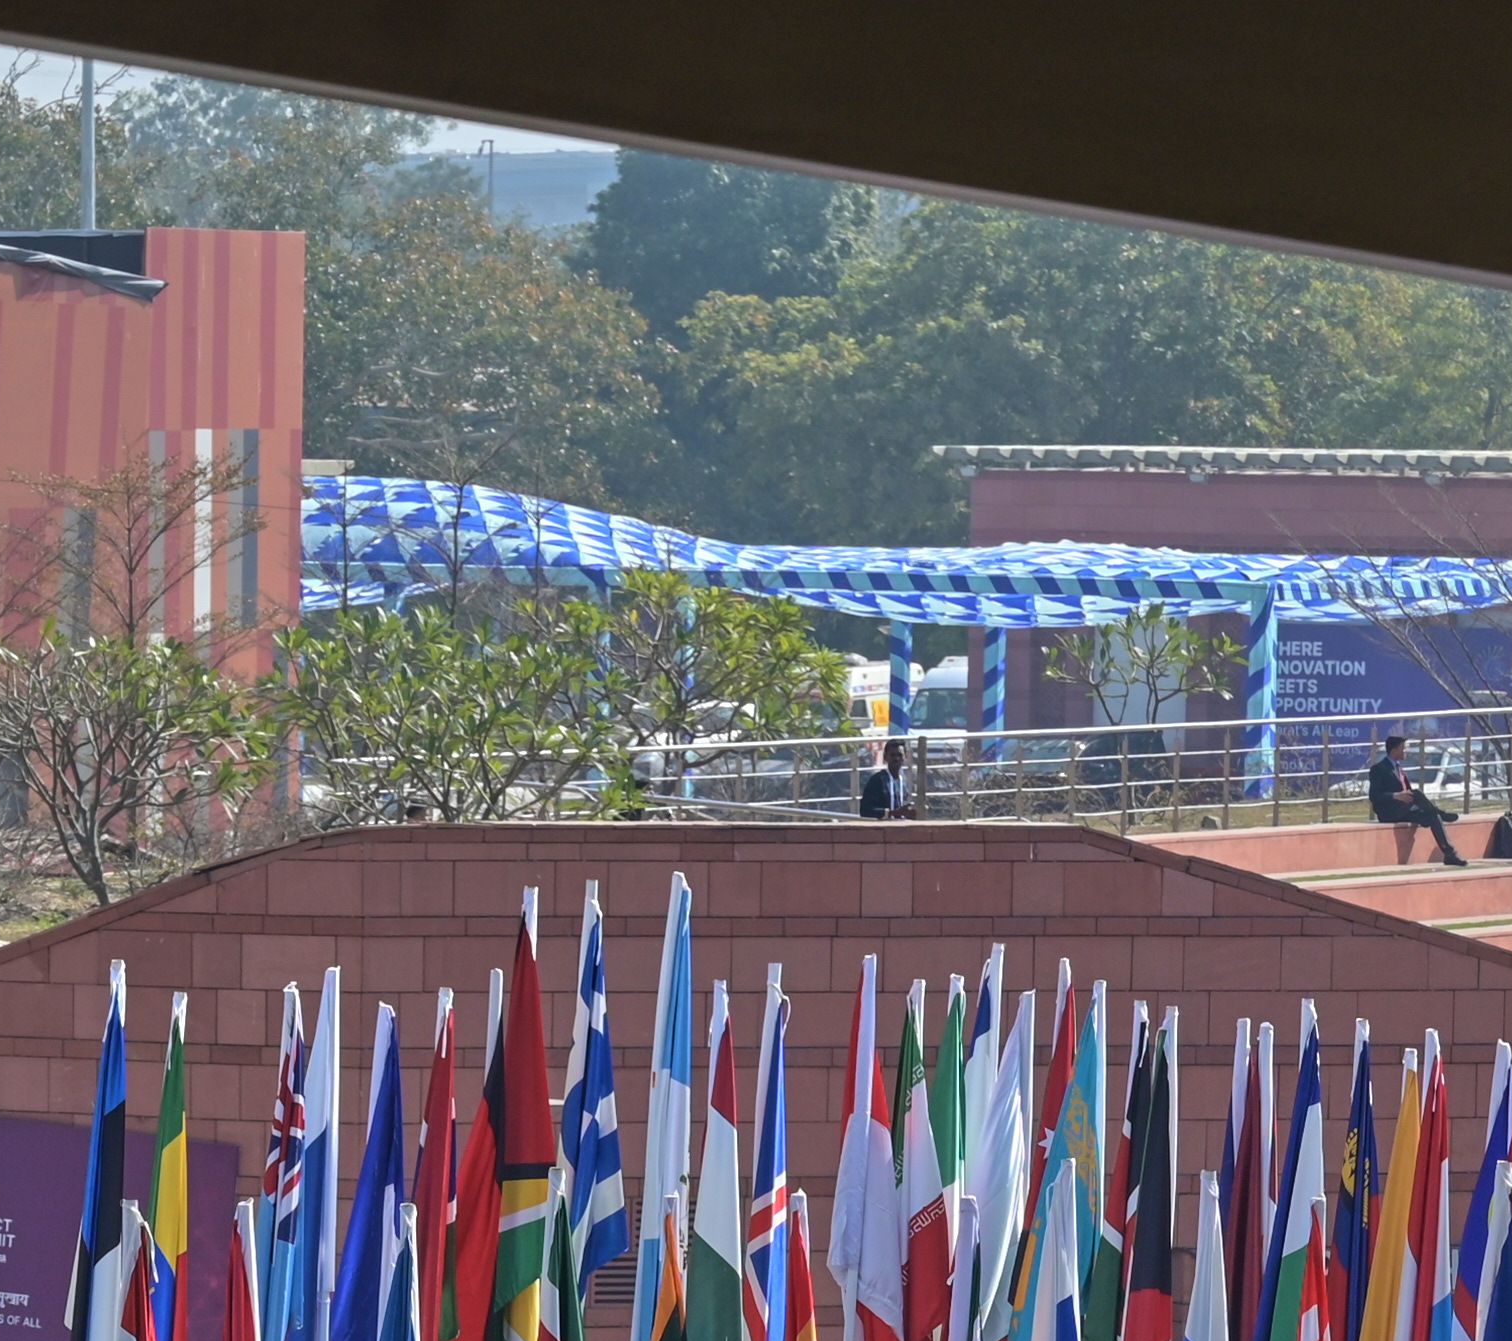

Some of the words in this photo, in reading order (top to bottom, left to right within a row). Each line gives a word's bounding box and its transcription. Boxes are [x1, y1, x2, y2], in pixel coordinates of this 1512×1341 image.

[1276, 640, 1322, 657] HERE
[1277, 660, 1366, 677] NOVATION
[1276, 679, 1318, 694] EETS
[1276, 697, 1383, 714] PPORTUNITY
[7, 1314, 22, 1326] OF
[23, 1317, 43, 1329] ALL
